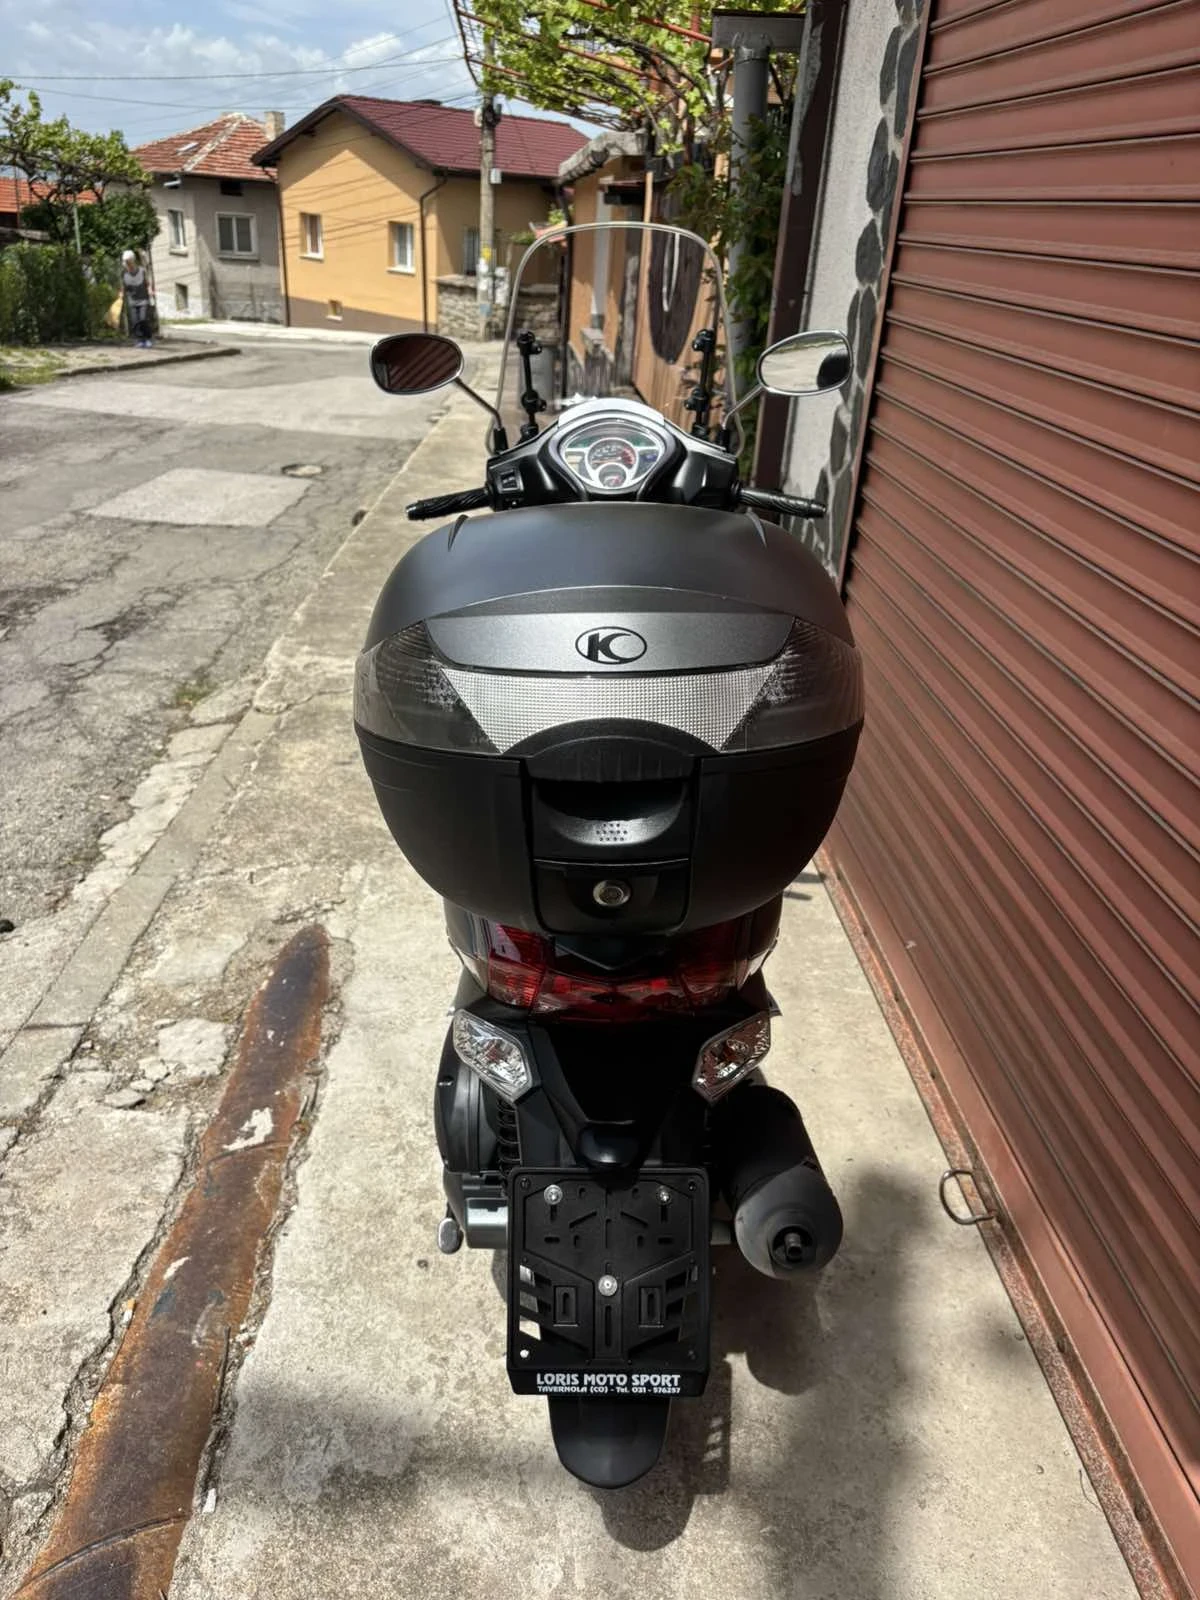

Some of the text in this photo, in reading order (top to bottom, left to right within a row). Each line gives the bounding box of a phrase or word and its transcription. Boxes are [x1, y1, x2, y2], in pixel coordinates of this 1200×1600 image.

[537, 1373, 680, 1387] LORIS MOTO SPORT
[537, 1385, 587, 1393] TAVERNOLA
